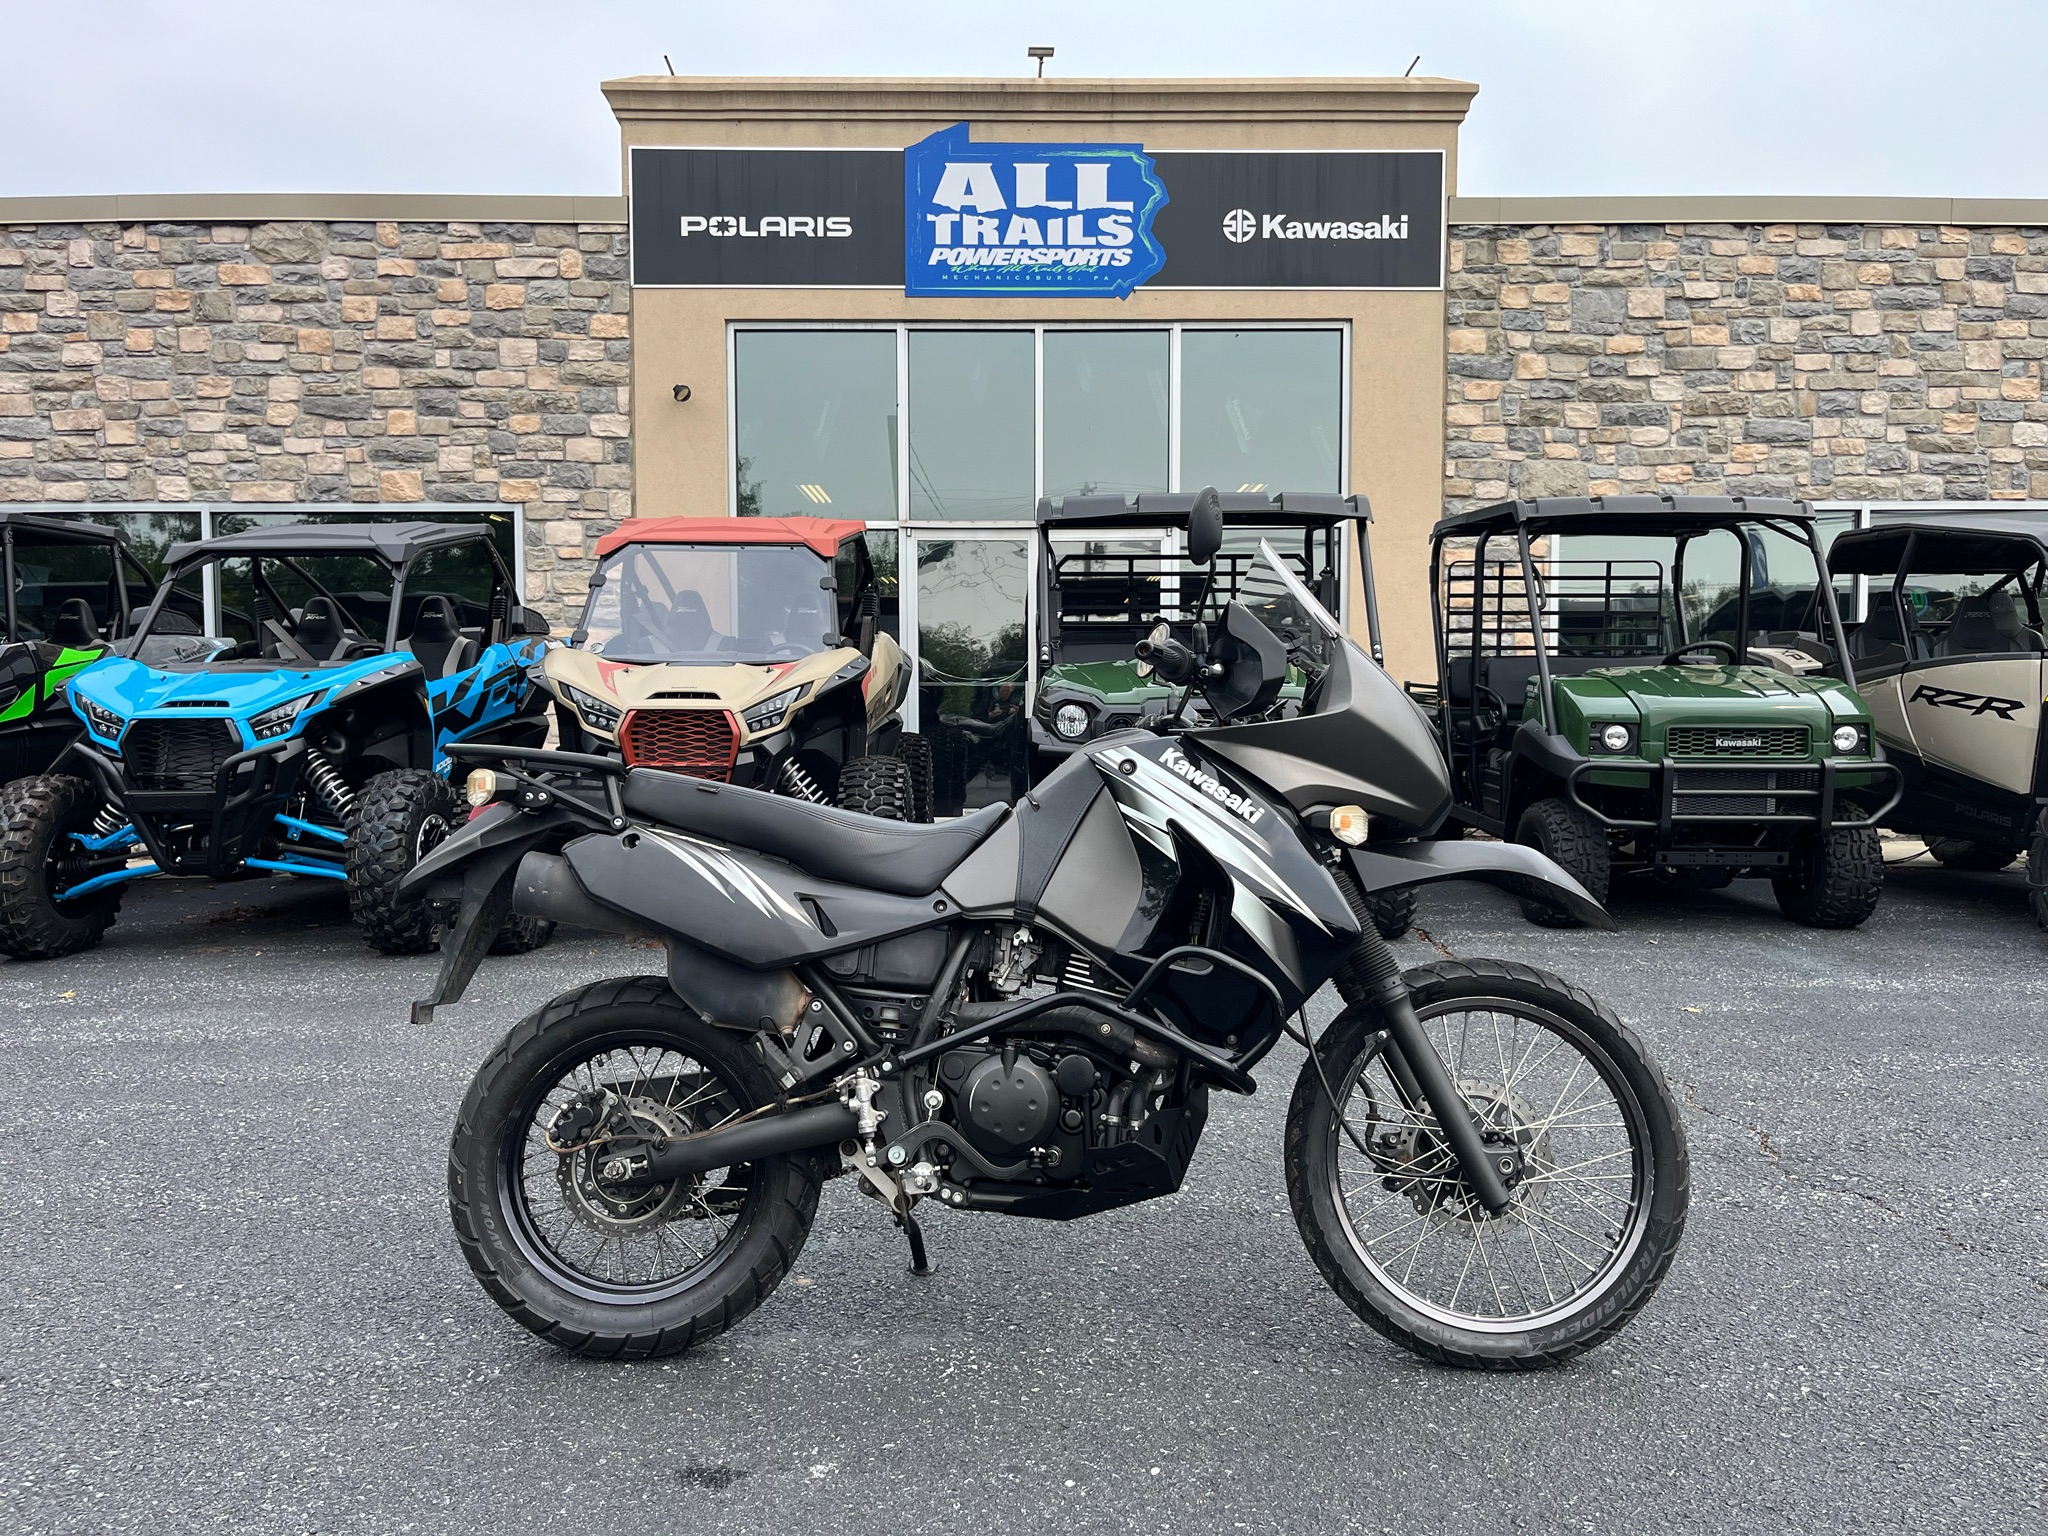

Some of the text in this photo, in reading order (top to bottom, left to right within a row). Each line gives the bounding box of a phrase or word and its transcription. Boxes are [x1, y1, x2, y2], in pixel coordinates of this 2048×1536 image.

[932, 163, 1134, 213] ALL
[680, 216, 853, 237] POLARIS
[926, 213, 1134, 247] TRAILS
[1262, 214, 1409, 240] Kawasaki
[928, 247, 1133, 267] POWERSPORTS
[950, 263, 995, 274] Where
[996, 263, 1025, 274] All
[1026, 263, 1064, 274] Trails
[1908, 684, 2026, 721] RZR
[1716, 738, 1761, 747] Kawasaki
[1158, 746, 1265, 825] Kawasaki
[1955, 803, 2012, 827] POLARIS
[479, 1201, 507, 1252] AVON
[1551, 1239, 1659, 1343] TRAILRIDER
